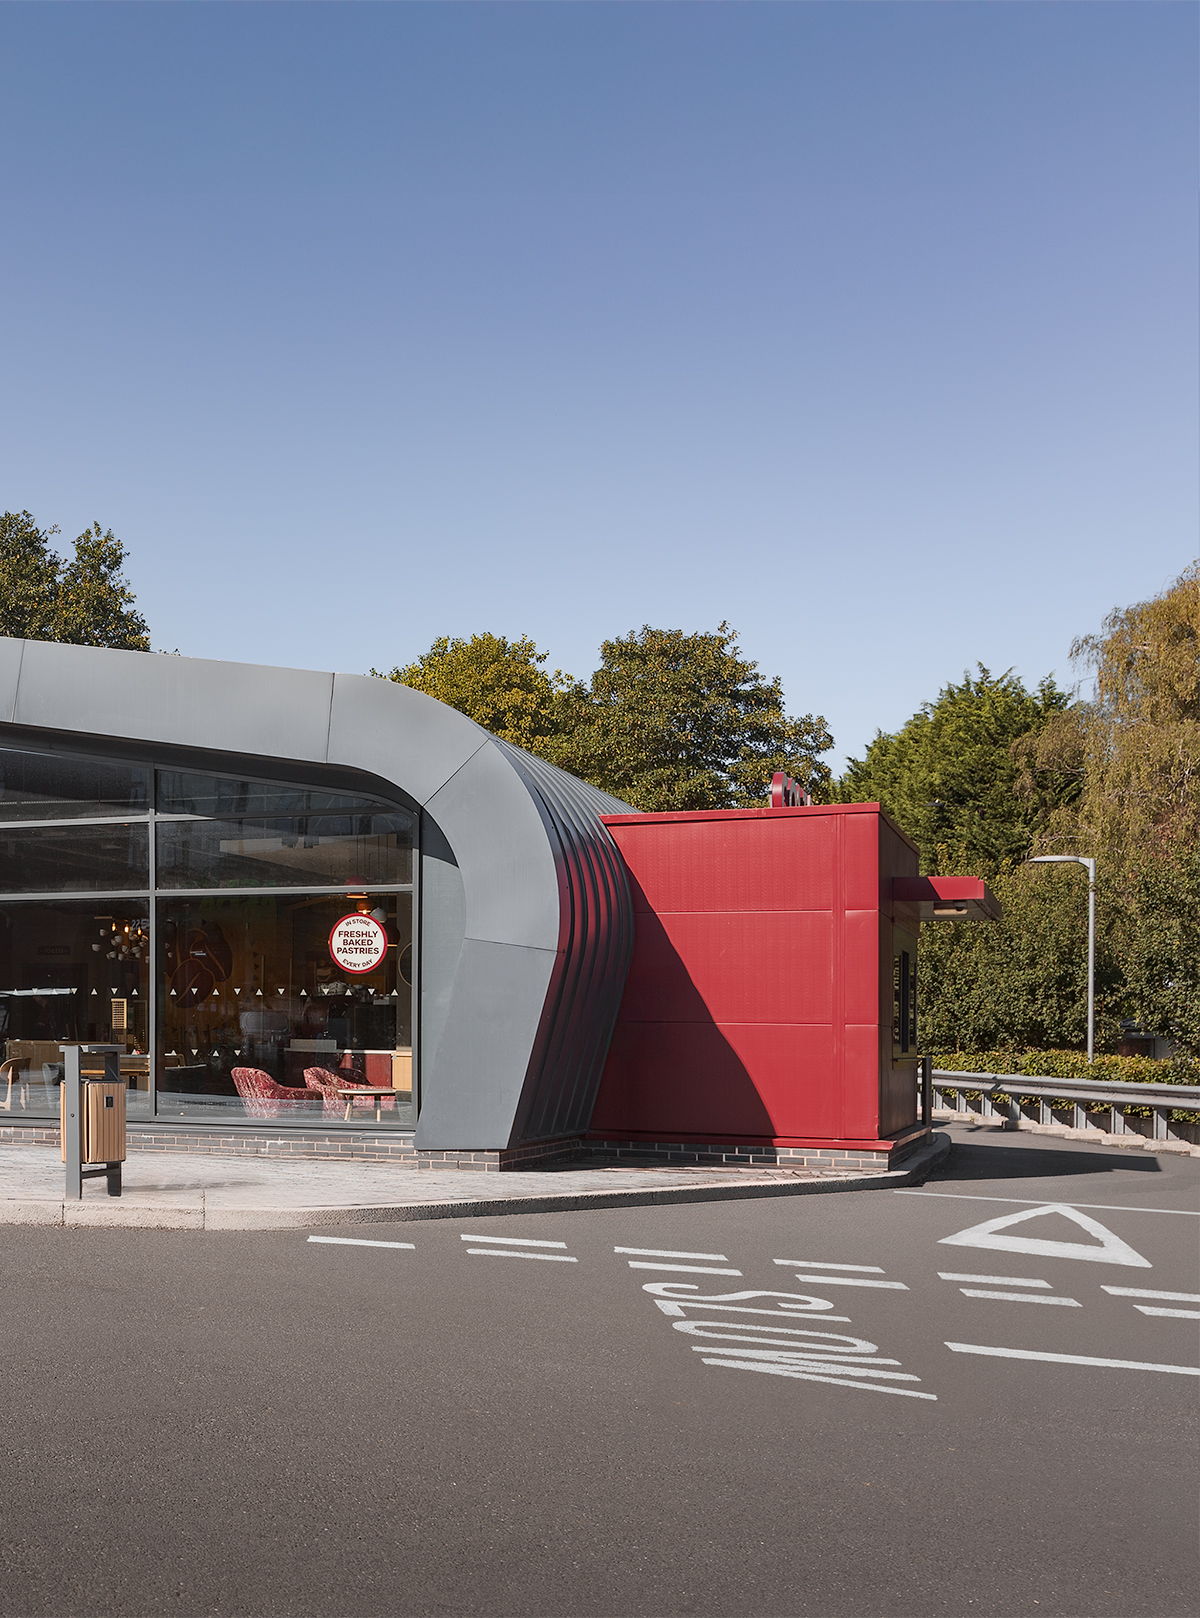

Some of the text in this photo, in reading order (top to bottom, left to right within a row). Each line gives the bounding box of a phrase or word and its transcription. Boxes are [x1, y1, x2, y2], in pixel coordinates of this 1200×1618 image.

[352, 918, 372, 927] STORE
[338, 930, 379, 938] FRESHLY
[336, 947, 380, 955] PASTRIES
[342, 958, 373, 968] EVERY DAY
[642, 1282, 938, 1401] SLOW
